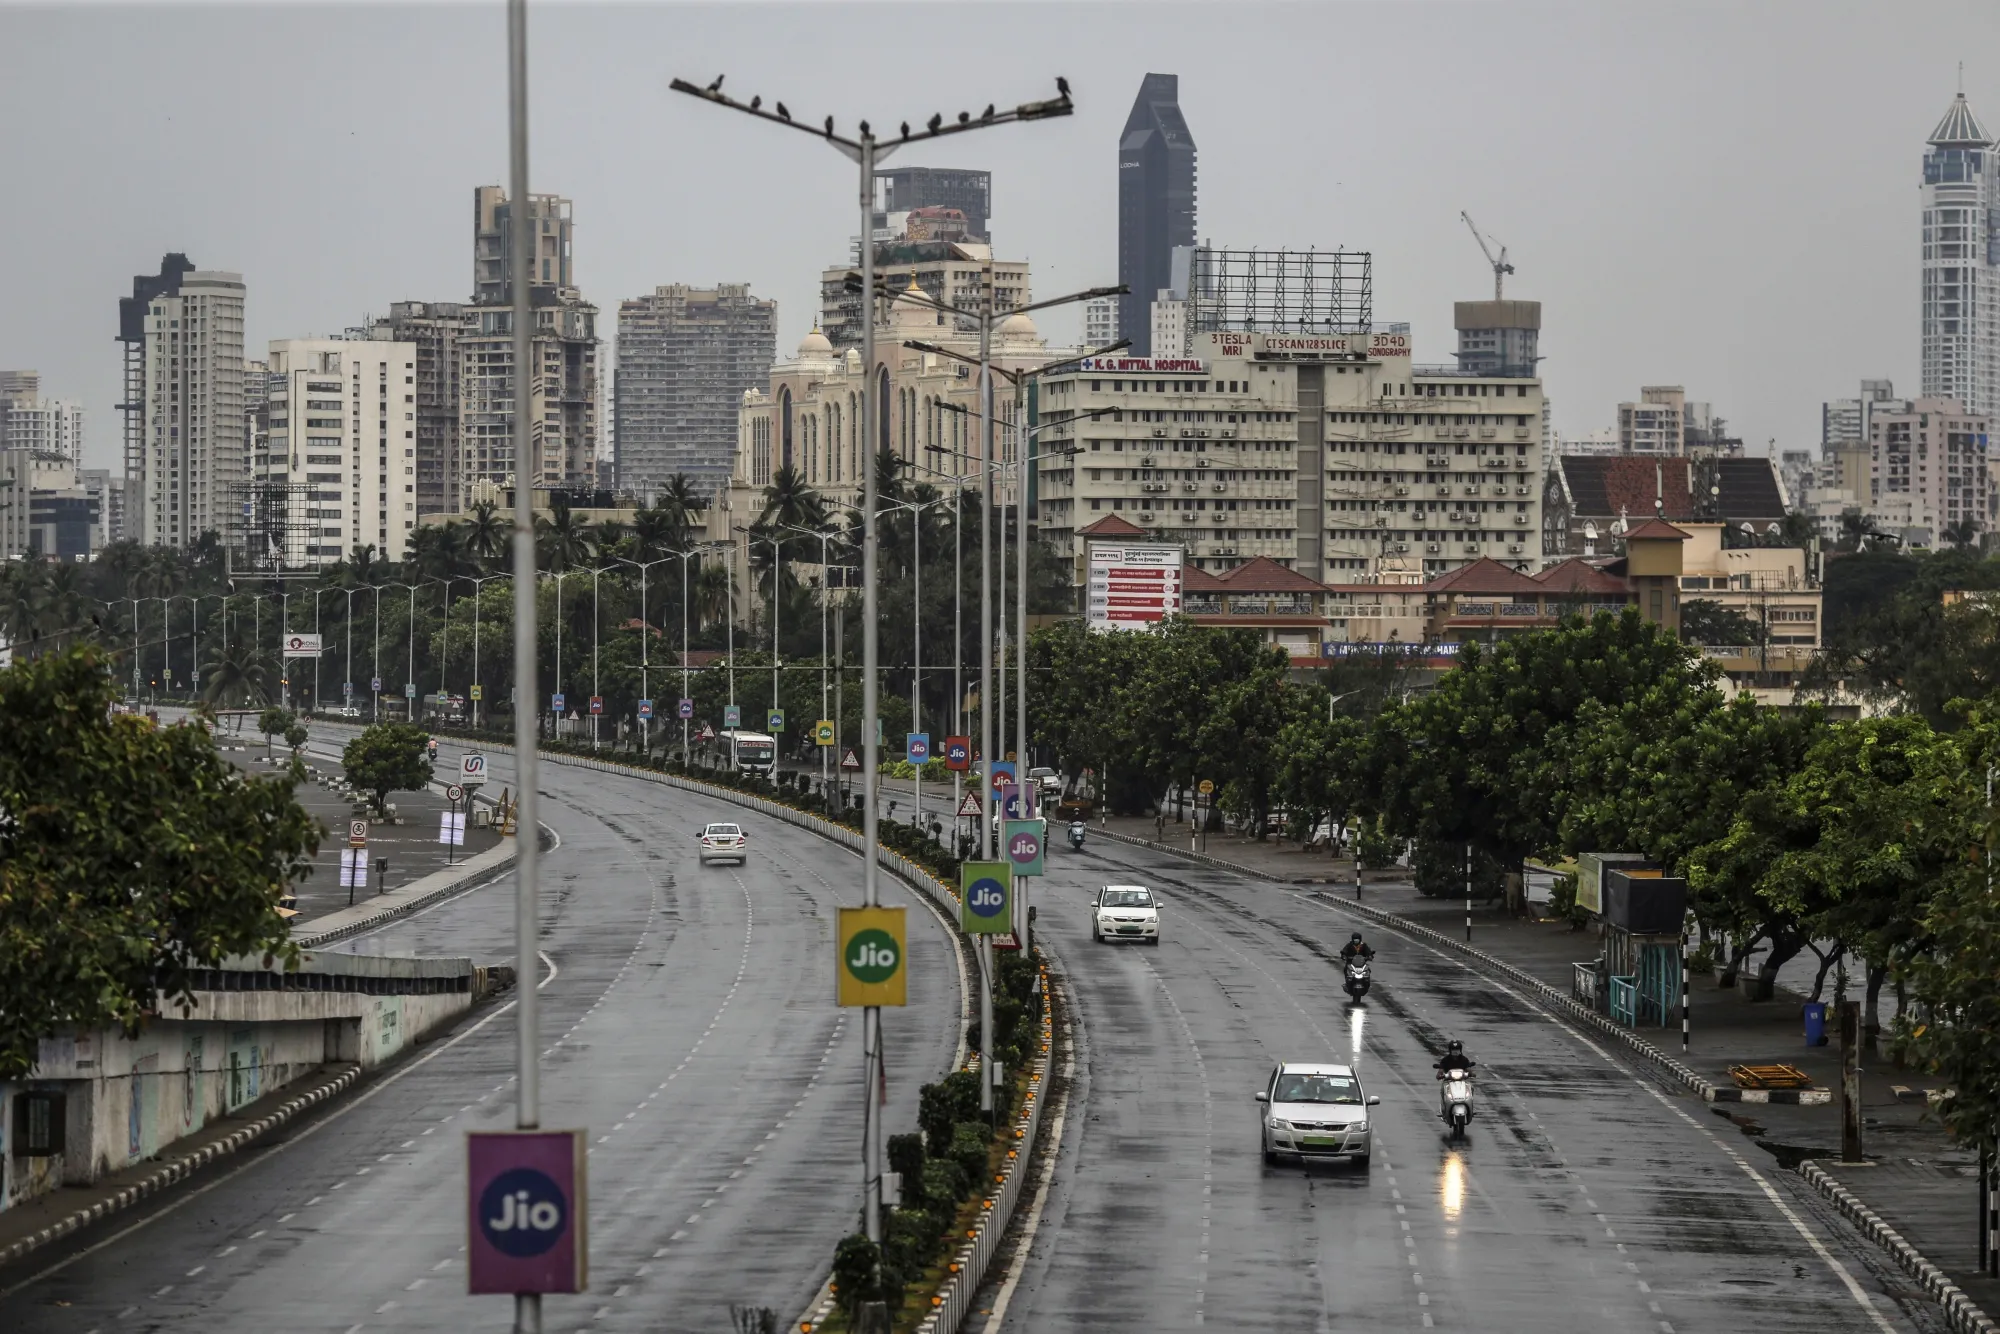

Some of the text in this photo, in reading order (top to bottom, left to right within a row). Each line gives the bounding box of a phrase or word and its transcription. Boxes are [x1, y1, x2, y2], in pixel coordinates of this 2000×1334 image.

[1212, 334, 1252, 344] 3 TESLA
[1374, 336, 1405, 346] 3D 4D
[1266, 339, 1346, 350] CT SCAN 128 SLICE
[1222, 346, 1242, 356] MRI
[1368, 348, 1410, 356] SONOGRAPHY
[1095, 359, 1202, 371] K. G. MITTAL HOSPITAL
[912, 744, 925, 752] Jio
[950, 748, 965, 758] Jio
[994, 776, 1011, 786] Jio
[1012, 840, 1037, 854] Jio
[971, 888, 1002, 906] Jio
[852, 942, 896, 967] Jio
[489, 1190, 560, 1232] Jio
